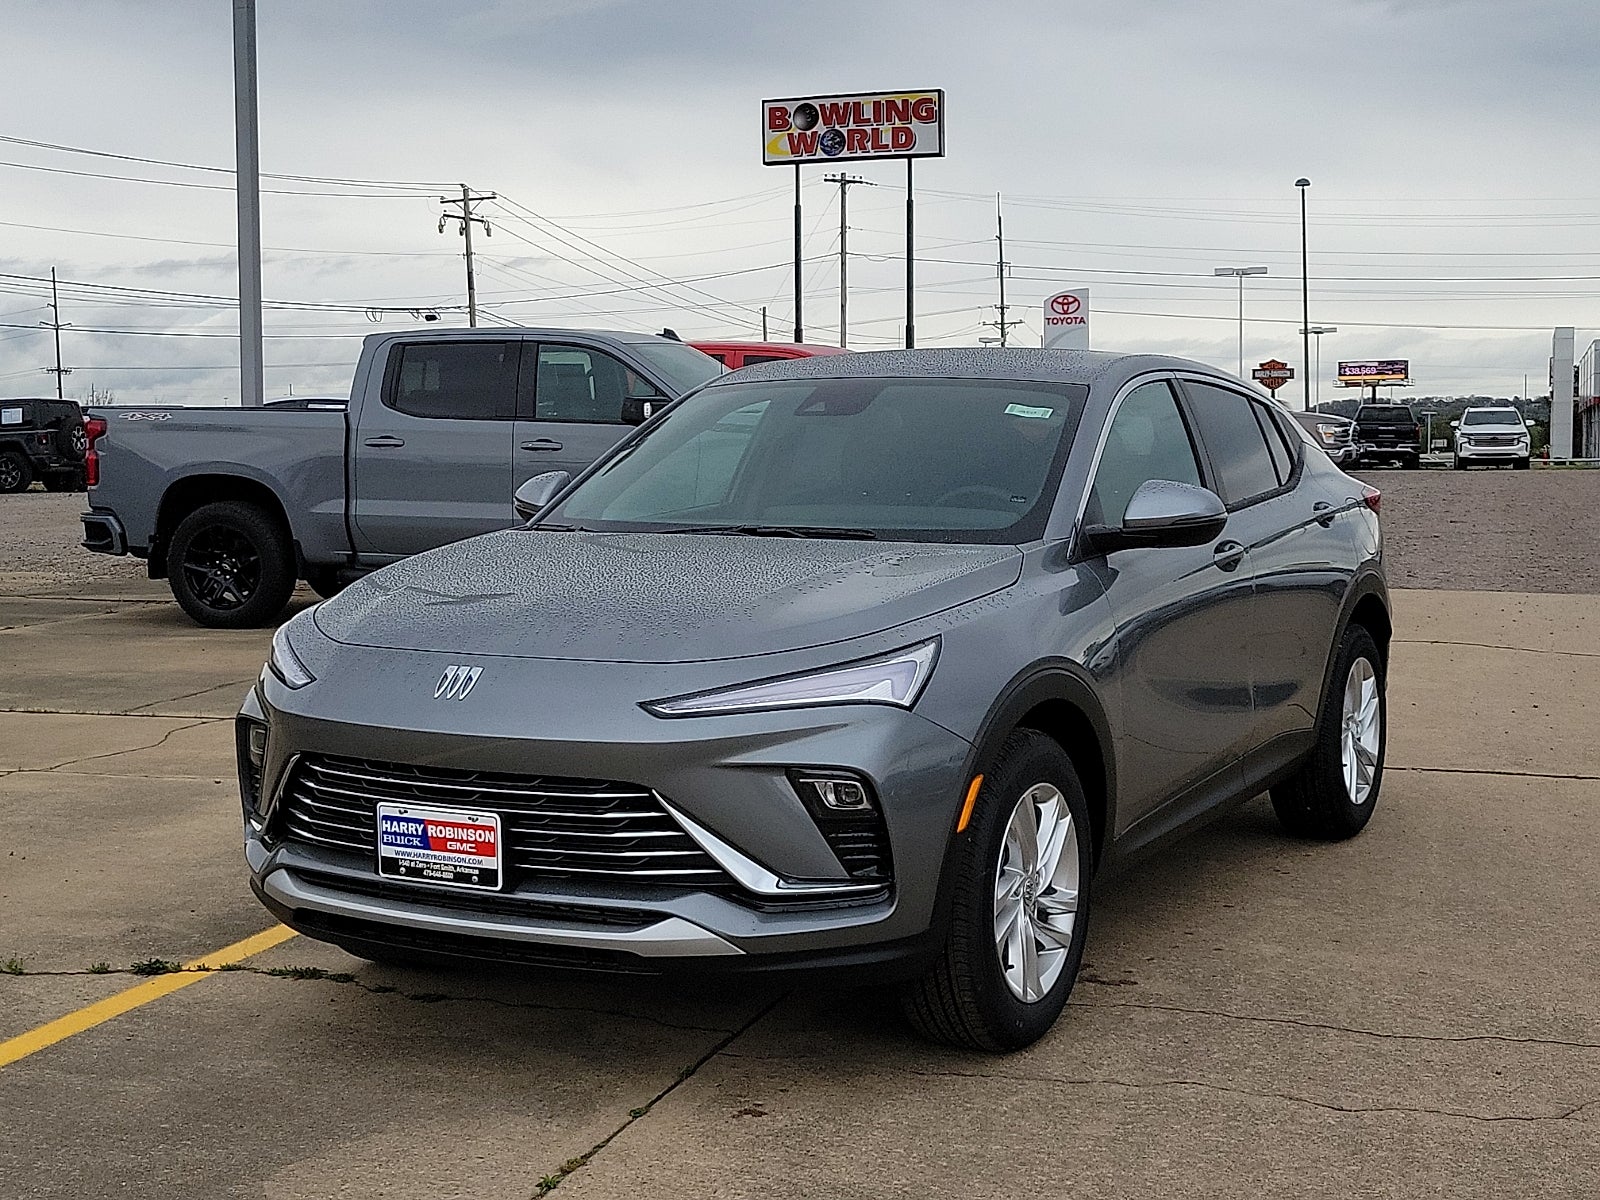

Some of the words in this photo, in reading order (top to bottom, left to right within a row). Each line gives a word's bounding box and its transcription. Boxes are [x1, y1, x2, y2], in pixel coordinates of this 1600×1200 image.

[768, 97, 936, 131] BOWLING
[786, 126, 915, 157] WORLD
[1045, 316, 1086, 326] TOYOTA
[382, 820, 424, 835] HARRY
[427, 824, 495, 843] ROBINSON
[383, 834, 424, 846] BUICK
[446, 841, 477, 852] GMC
[394, 849, 484, 866] WWW.HARRYROBINSON.COM
